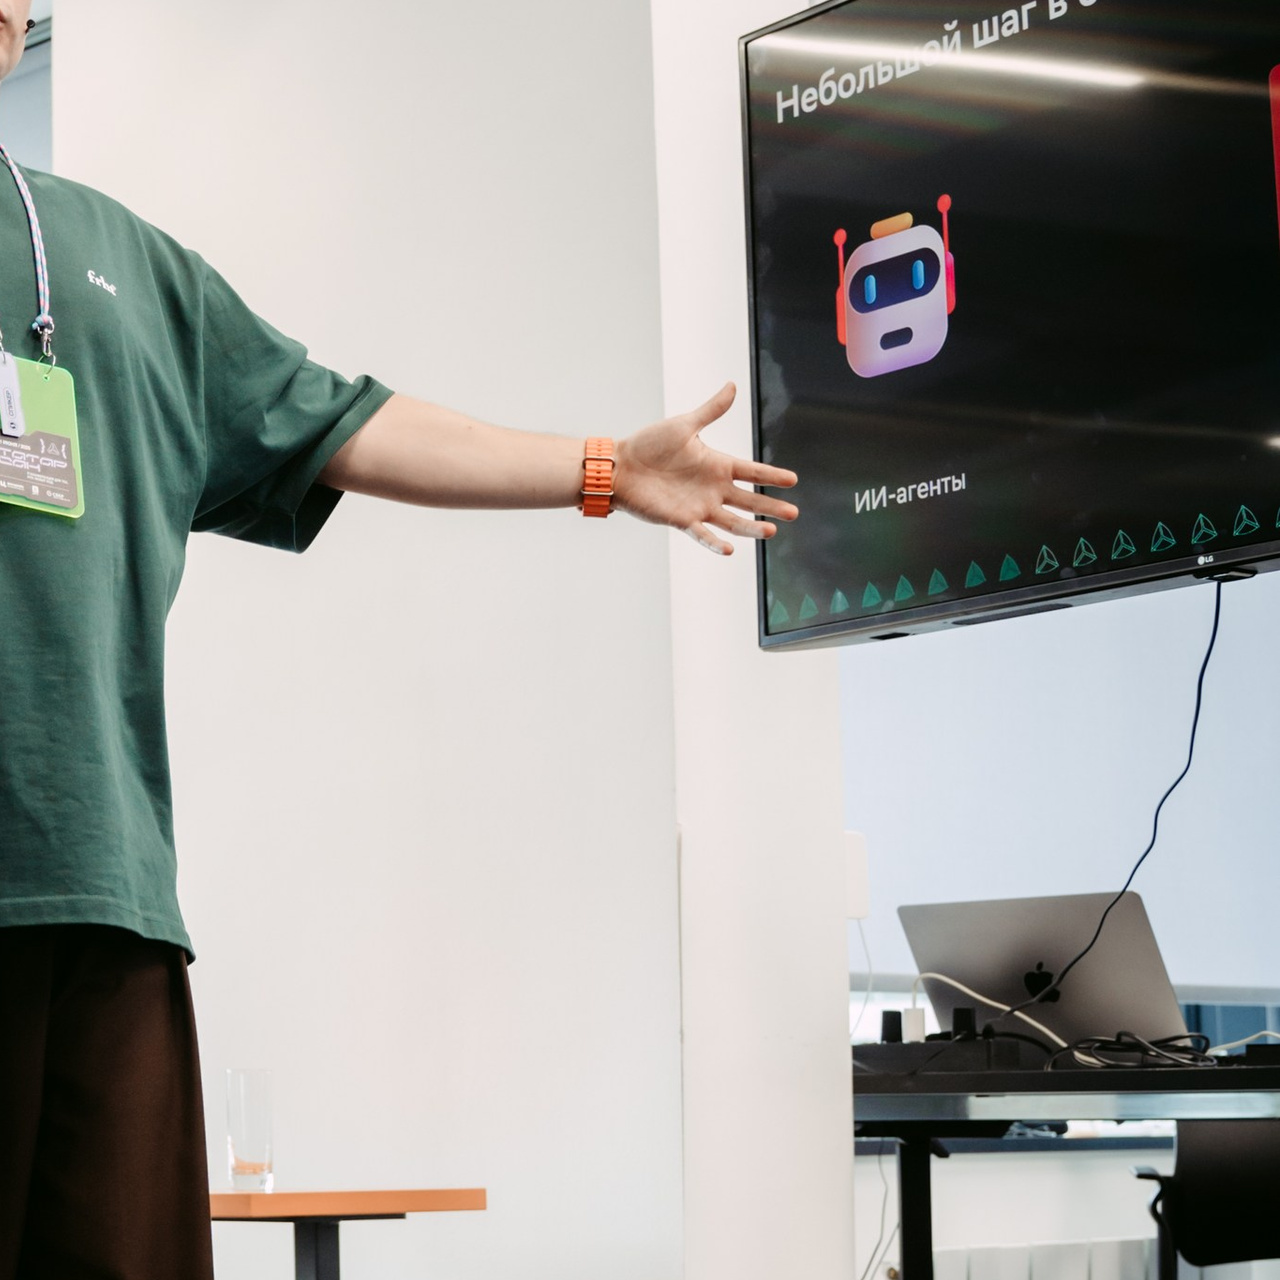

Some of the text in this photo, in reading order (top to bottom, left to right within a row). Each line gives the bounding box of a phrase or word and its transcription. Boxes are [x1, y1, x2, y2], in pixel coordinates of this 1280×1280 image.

[776, 19, 962, 124] Небольшой
[972, 0, 1037, 49] шаг
[854, 473, 966, 514] ИИ-агенты
[1205, 555, 1214, 563] LG
